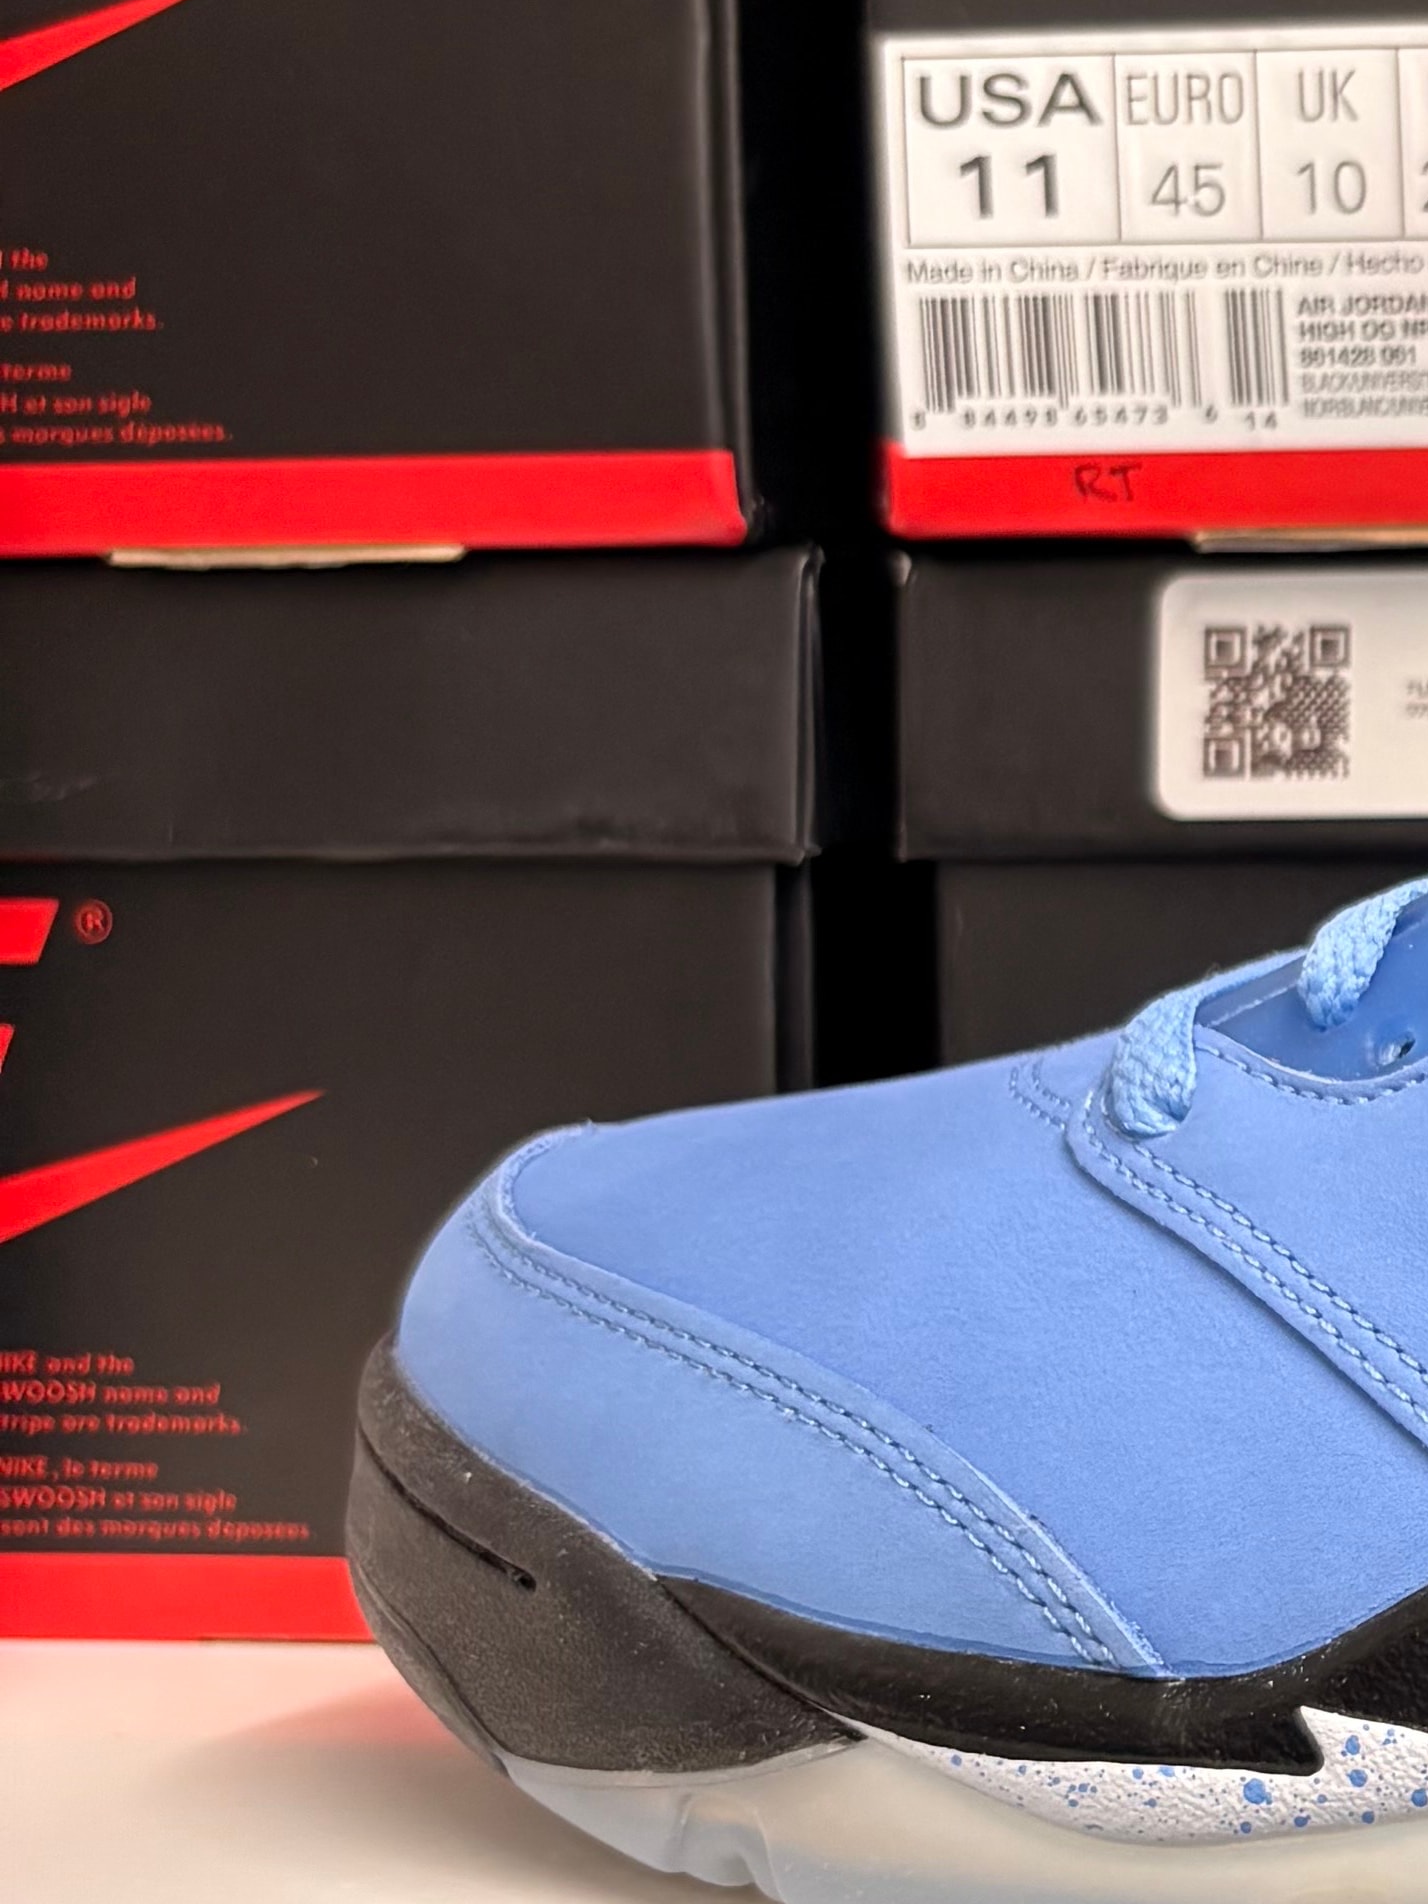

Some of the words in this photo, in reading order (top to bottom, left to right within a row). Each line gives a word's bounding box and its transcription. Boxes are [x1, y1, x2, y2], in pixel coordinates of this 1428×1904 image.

[918, 72, 1103, 130] USA
[1125, 71, 1244, 126] EURO
[1298, 68, 1359, 122] UK
[959, 154, 1059, 219] 11
[1148, 162, 1227, 219] 45
[1296, 160, 1367, 216] 10
[907, 256, 974, 283] Made
[981, 257, 1001, 283] in
[1009, 257, 1079, 284] China
[1102, 255, 1209, 286] Fabrique
[1216, 260, 1245, 279] en
[1346, 250, 1424, 275] Hecho
[89, 275, 136, 300] and
[1298, 296, 1336, 317] AIR
[1300, 320, 1354, 342] HIGH
[1361, 319, 1396, 341] OG
[45, 1352, 91, 1376] and
[96, 1351, 135, 1376] the
[173, 1382, 221, 1405] and
[55, 1516, 95, 1538] des
